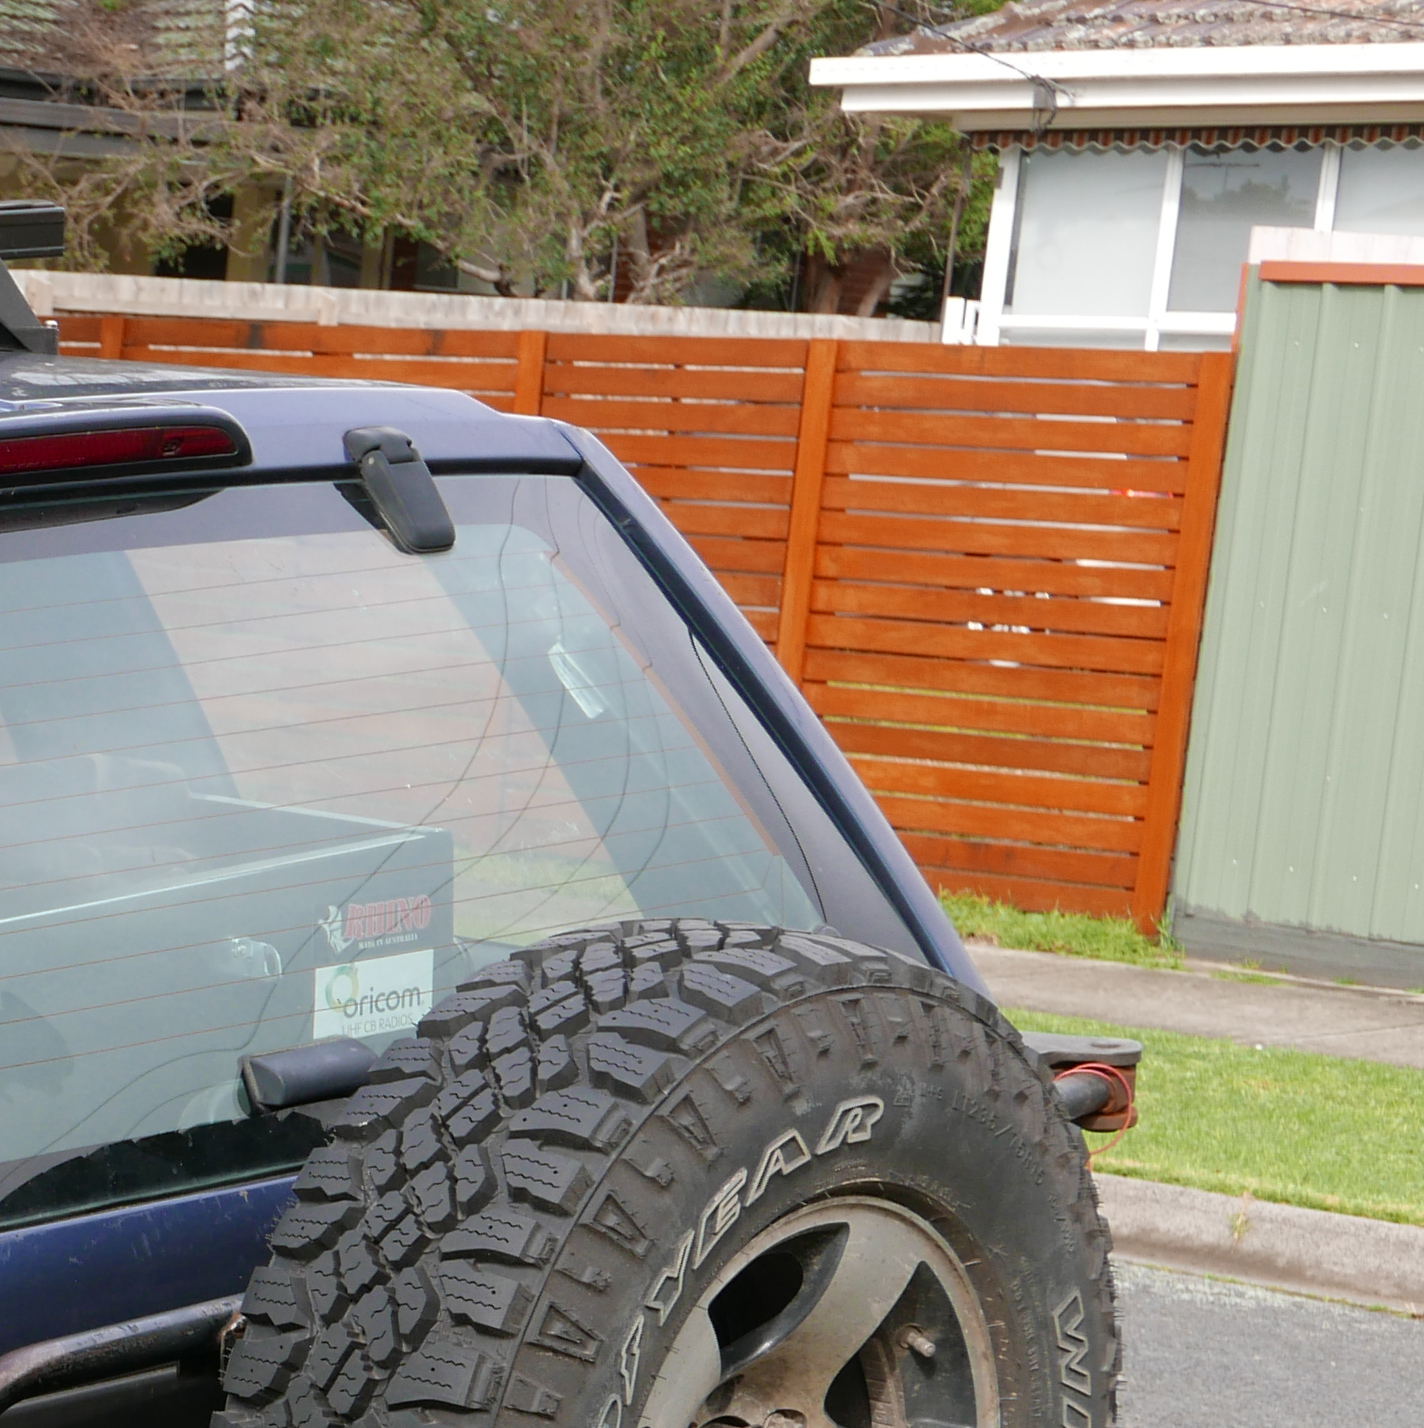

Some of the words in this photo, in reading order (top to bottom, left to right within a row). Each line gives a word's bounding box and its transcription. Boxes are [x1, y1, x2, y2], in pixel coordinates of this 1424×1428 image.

[344, 894, 432, 941] RHINO
[343, 987, 420, 1018] oricom
[342, 1023, 363, 1036] UHF
[364, 1020, 377, 1033] CB
[379, 1013, 413, 1030] RADIOS
